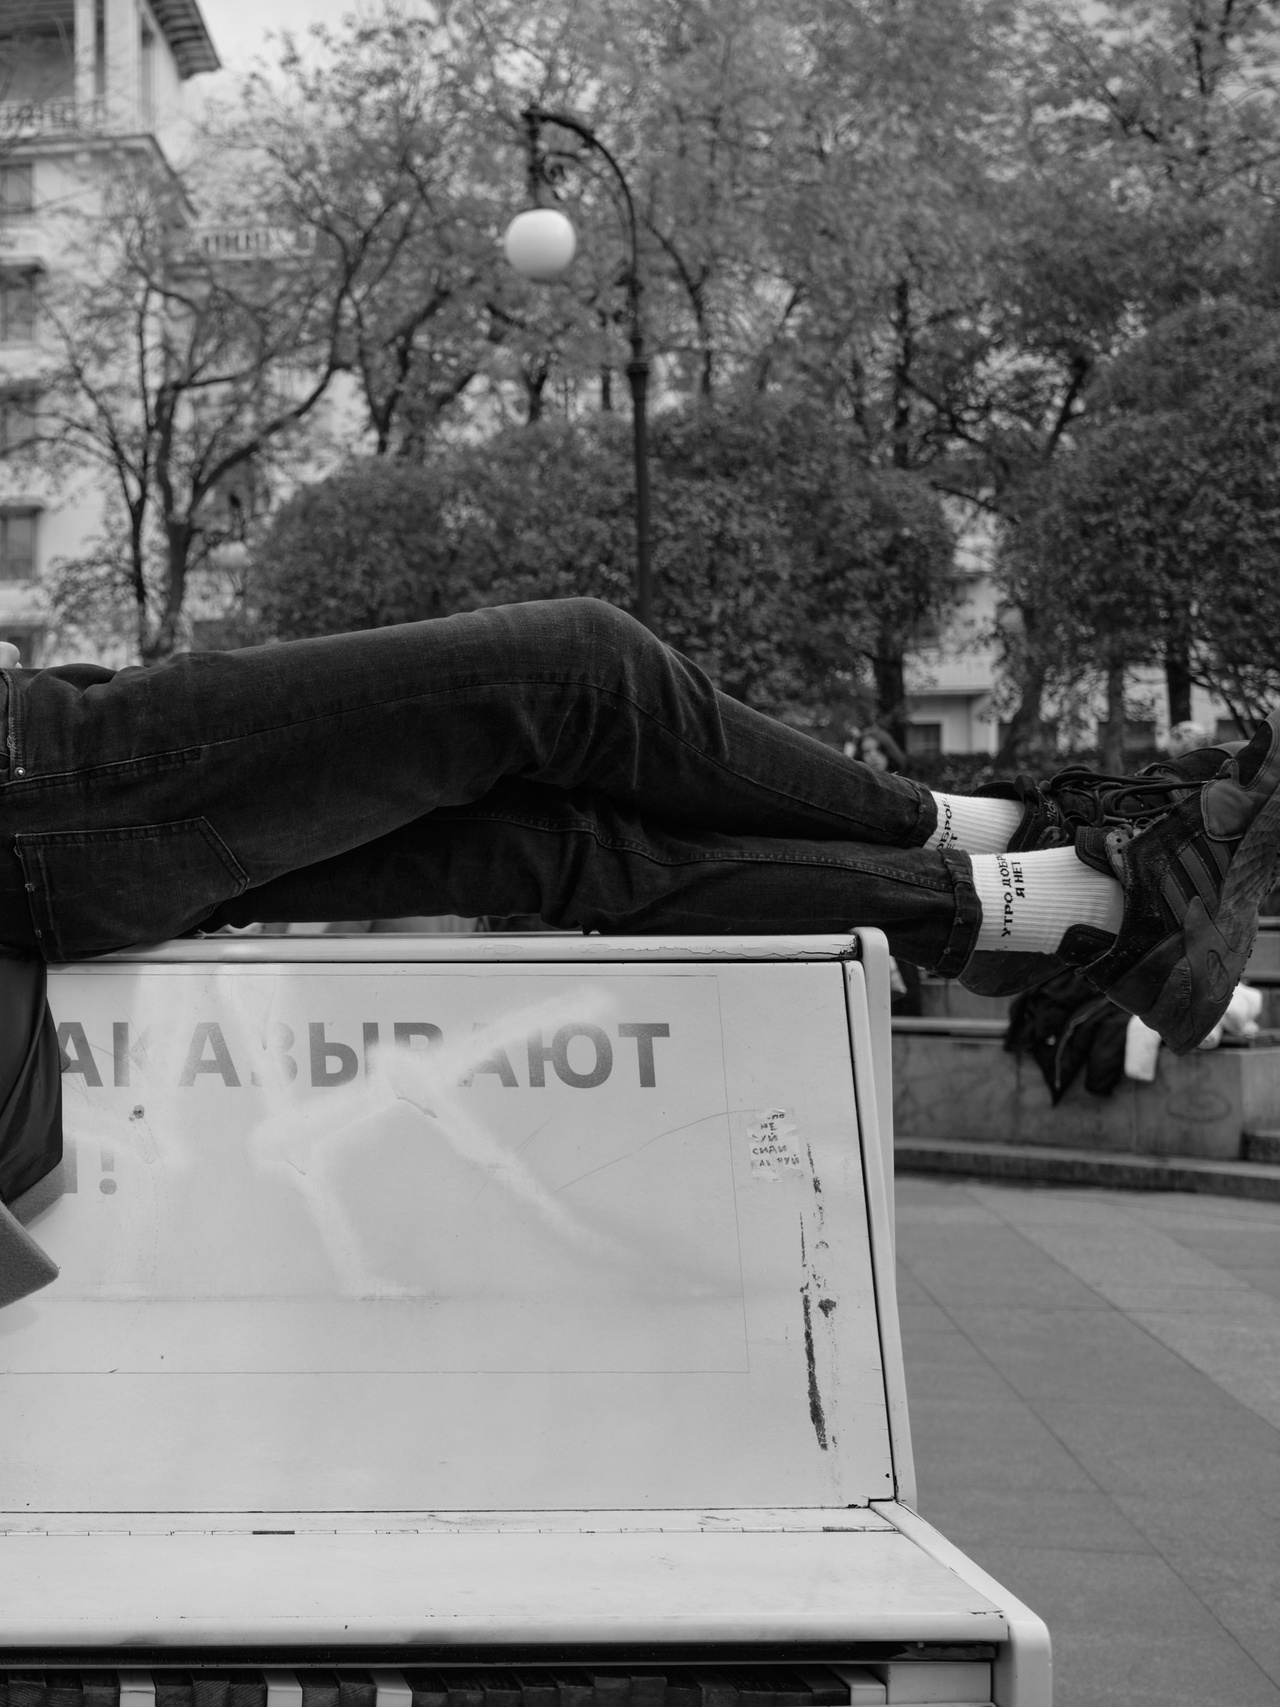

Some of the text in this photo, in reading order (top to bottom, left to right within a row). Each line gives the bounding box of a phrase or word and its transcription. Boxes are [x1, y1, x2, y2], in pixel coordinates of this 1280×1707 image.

[996, 854, 1012, 888] ДОБР
[1011, 861, 1025, 898] Я НЕТ
[1001, 892, 1013, 937] УТРО
